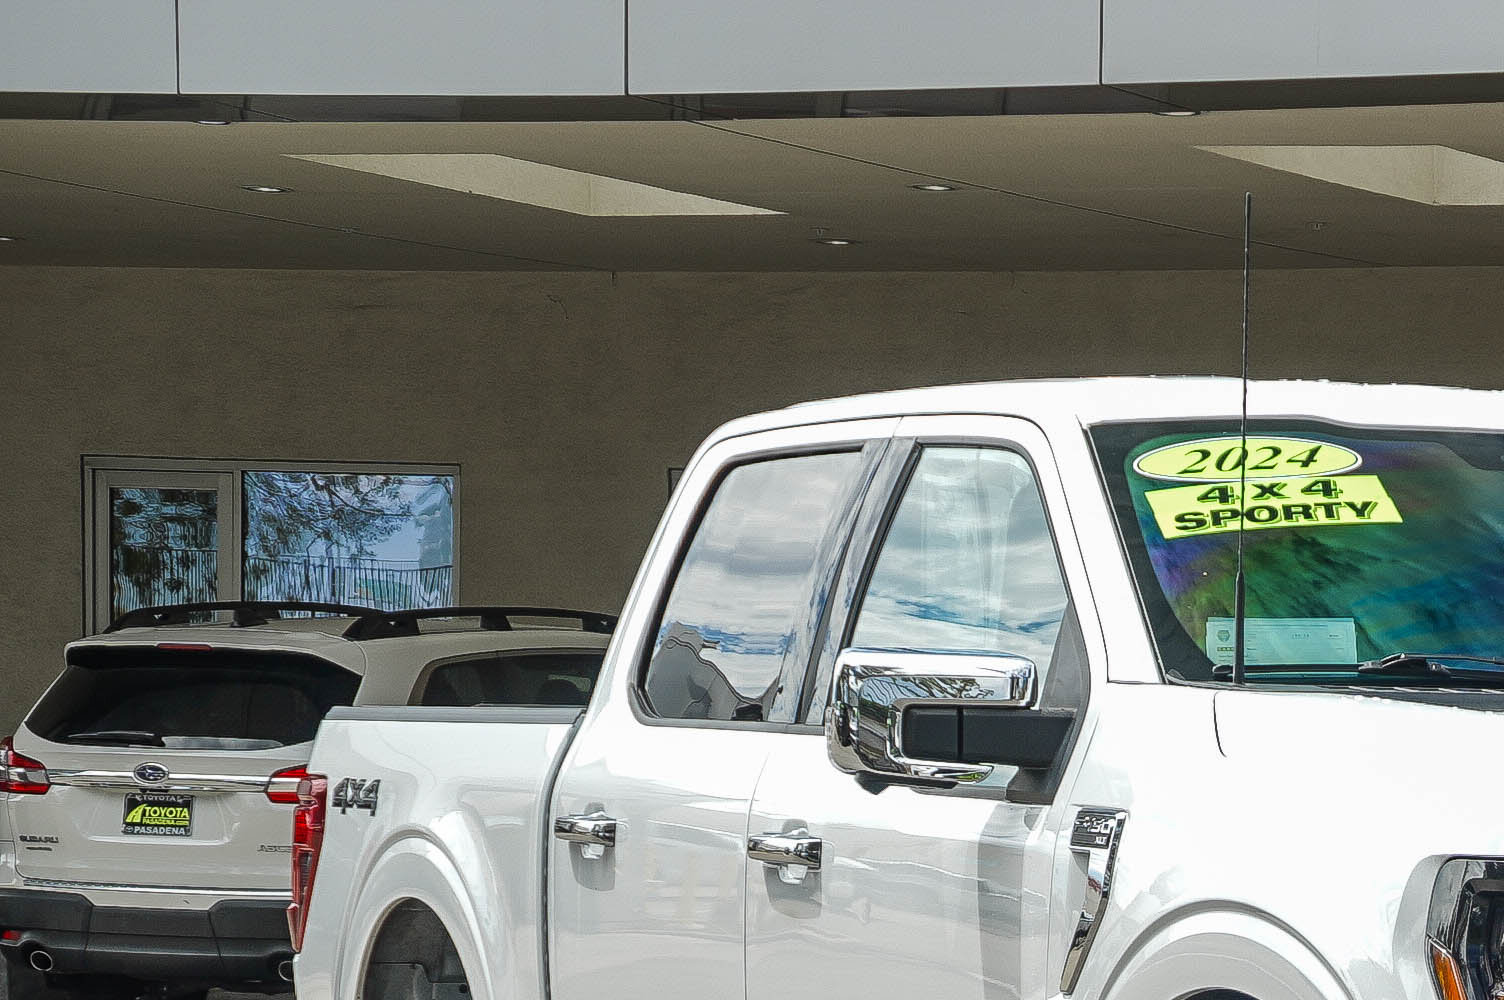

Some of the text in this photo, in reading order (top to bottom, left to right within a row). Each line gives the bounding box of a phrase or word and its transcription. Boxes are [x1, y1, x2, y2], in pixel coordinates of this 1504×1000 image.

[1176, 444, 1323, 475] 2024
[1174, 500, 1379, 531] SPORTY
[144, 806, 190, 819] TOYOTA
[134, 826, 186, 835] PASADENA
